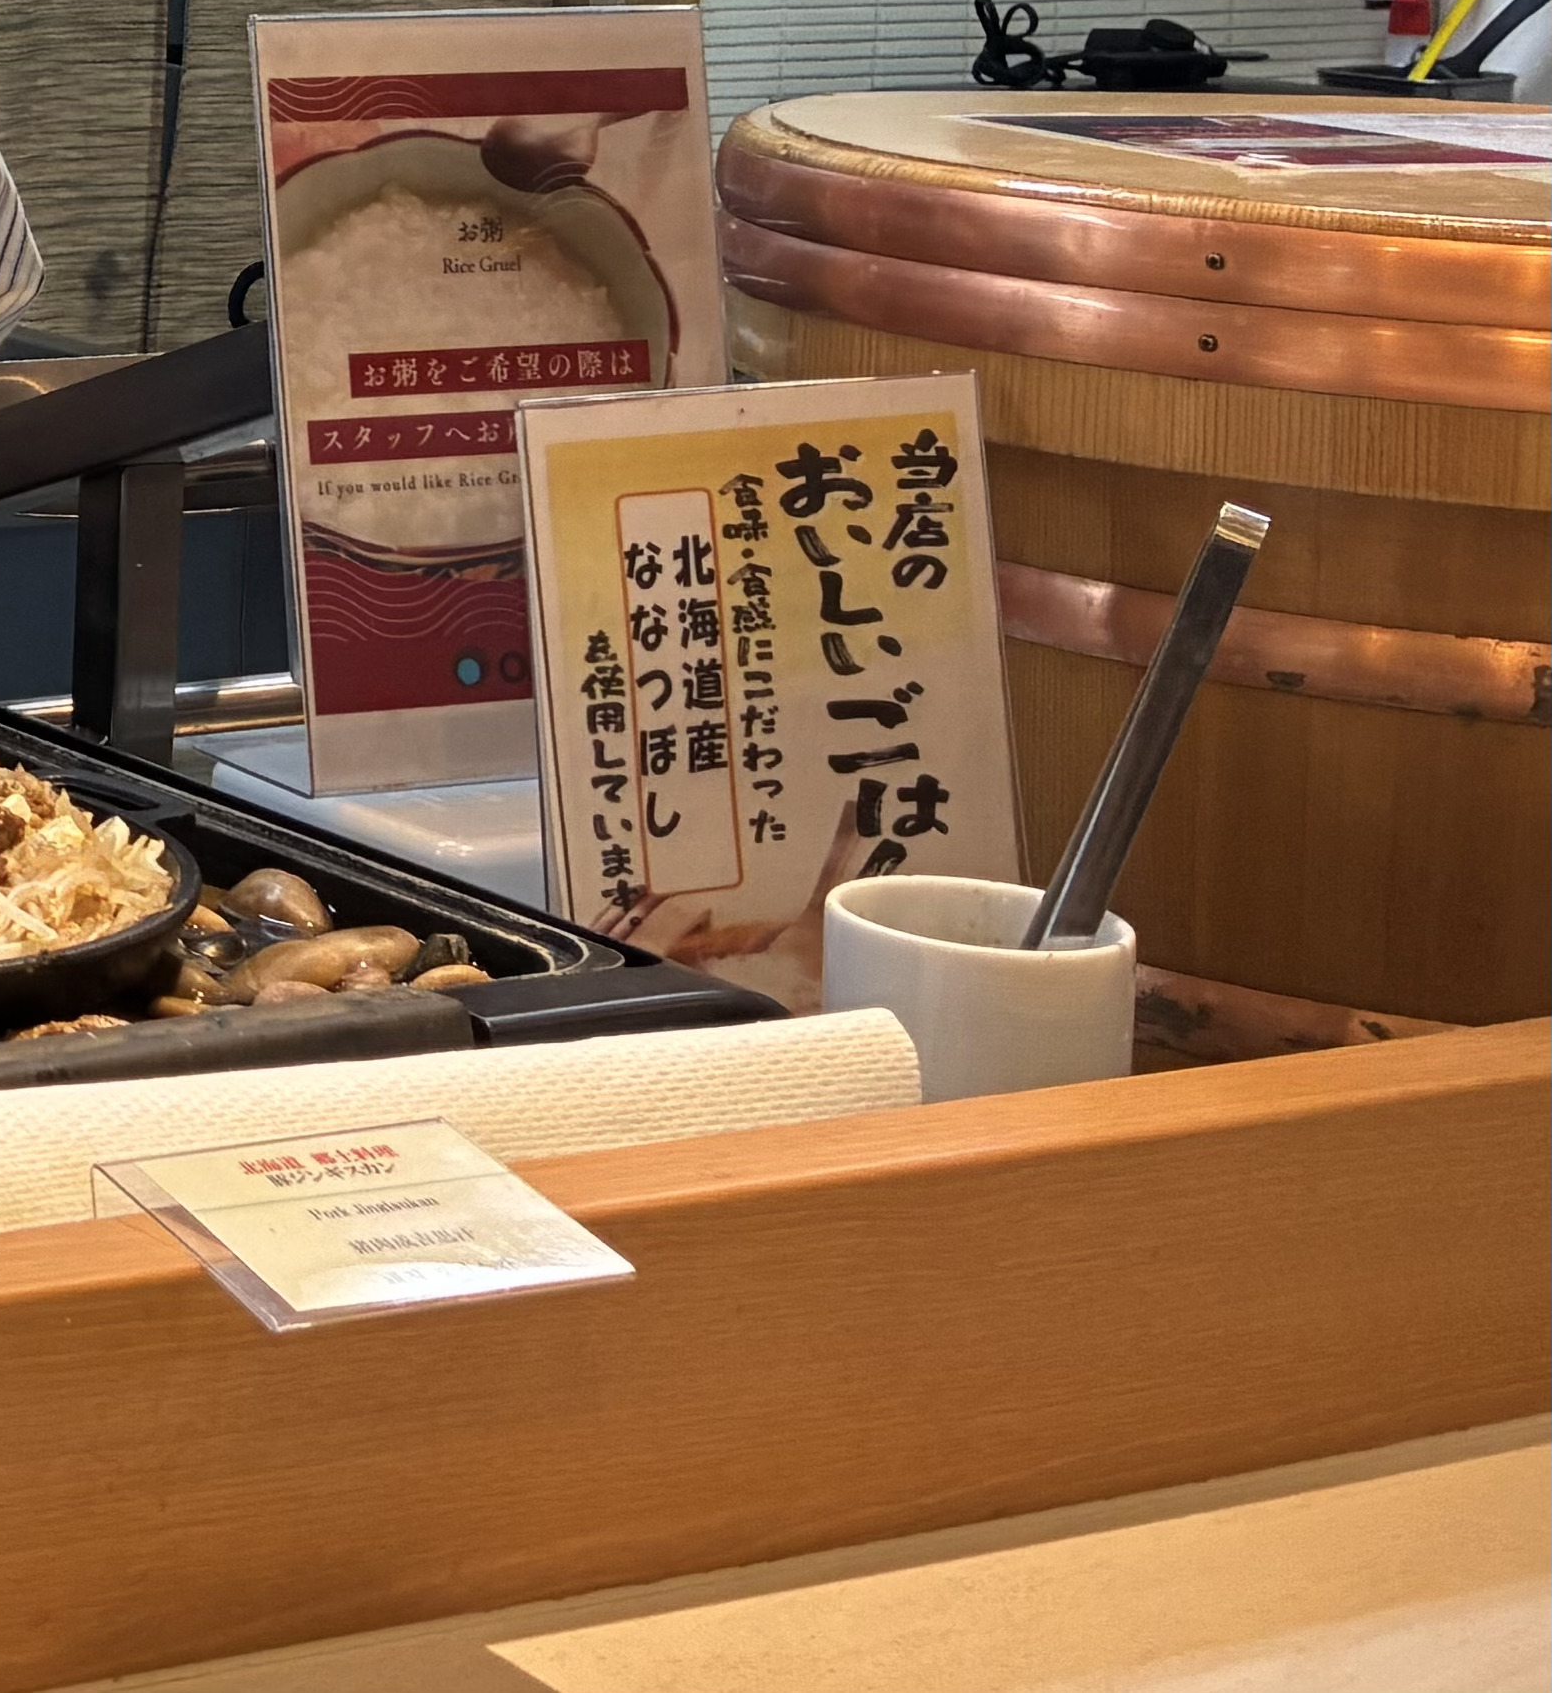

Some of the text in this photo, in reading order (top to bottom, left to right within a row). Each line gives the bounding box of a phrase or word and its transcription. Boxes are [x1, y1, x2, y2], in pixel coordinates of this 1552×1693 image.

[457, 216, 504, 244] お粥
[442, 255, 522, 275] Rice Gruel
[363, 349, 633, 388] お粥をご希望の際は
[337, 482, 364, 499] you
[371, 476, 417, 492] would
[423, 473, 452, 490] like
[459, 472, 492, 487] Rice
[882, 428, 958, 590] 当店の
[672, 534, 729, 774] 北海道産
